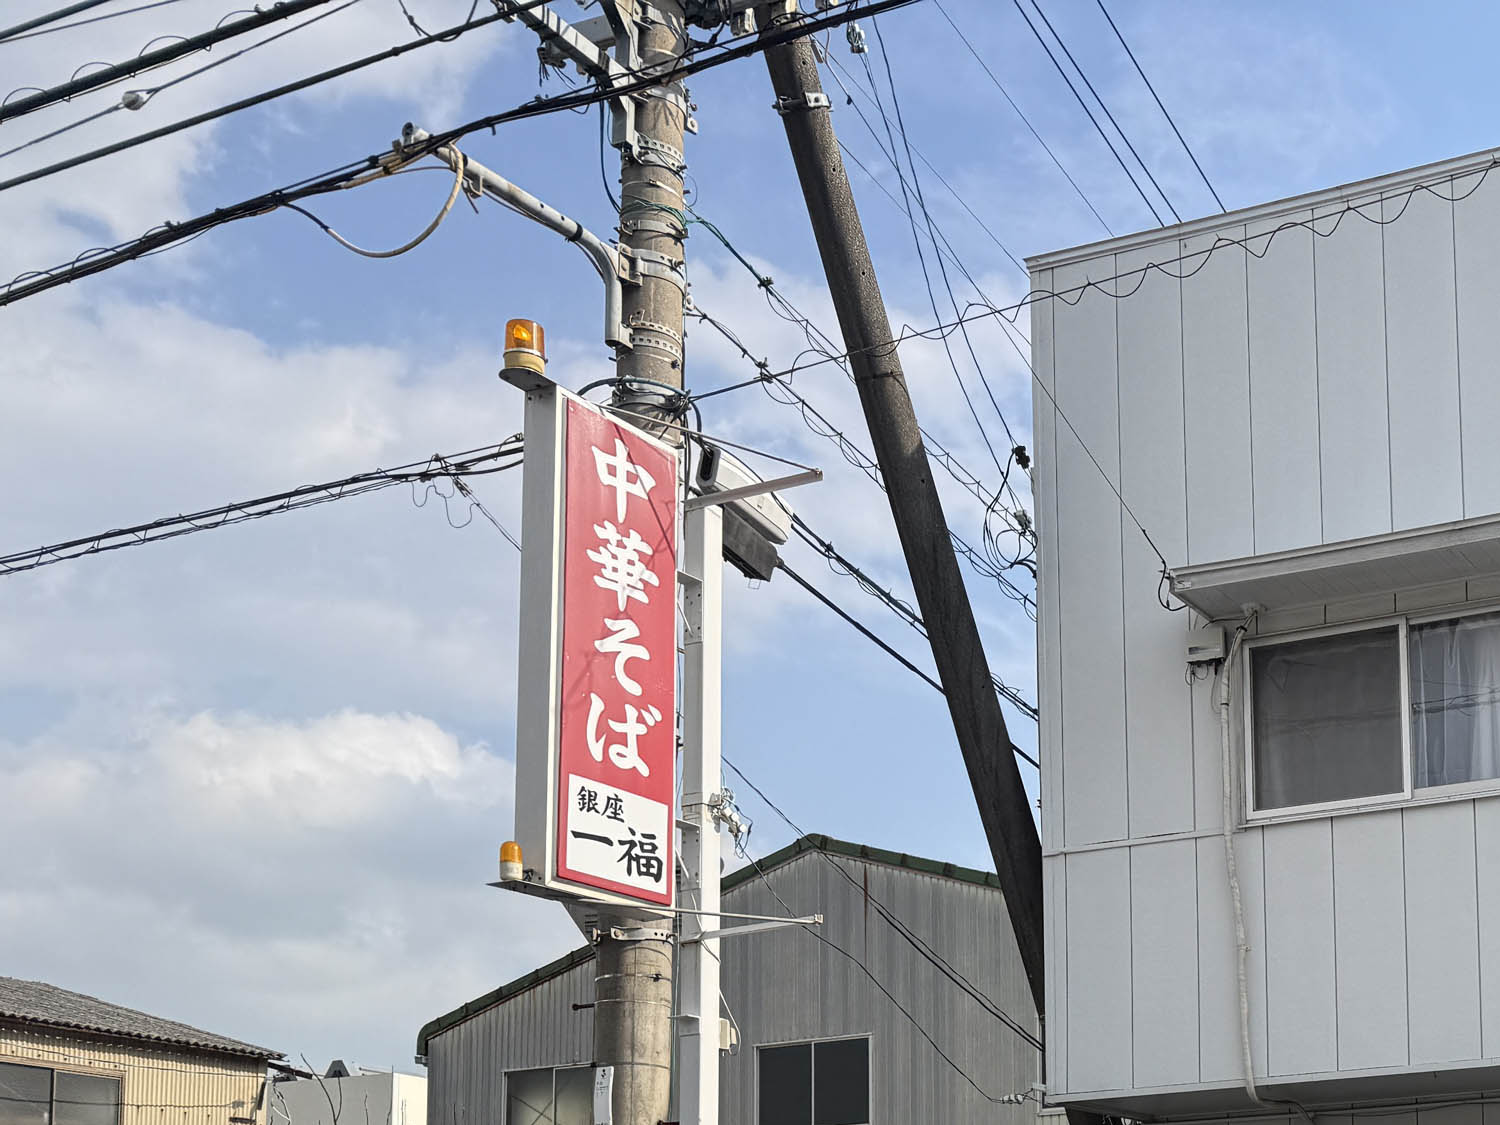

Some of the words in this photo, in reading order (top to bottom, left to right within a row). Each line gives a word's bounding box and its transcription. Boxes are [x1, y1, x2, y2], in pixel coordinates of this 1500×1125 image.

[586, 437, 662, 778] 中華そば
[576, 785, 625, 823] 銀座
[570, 825, 664, 884] 一福
